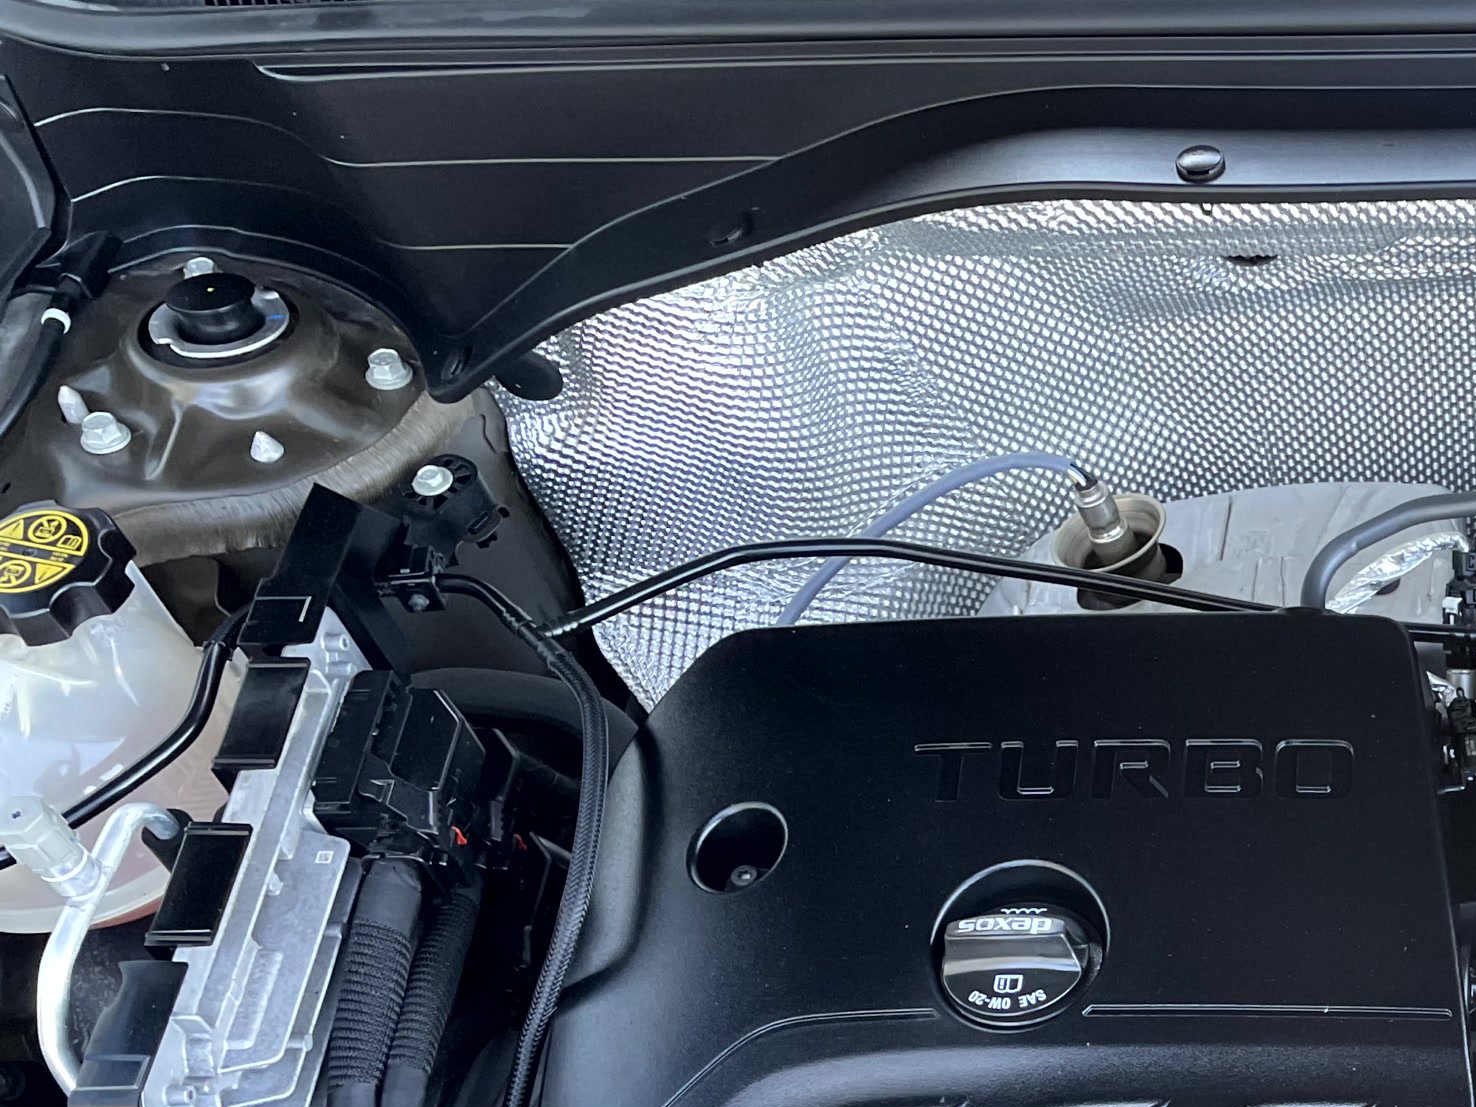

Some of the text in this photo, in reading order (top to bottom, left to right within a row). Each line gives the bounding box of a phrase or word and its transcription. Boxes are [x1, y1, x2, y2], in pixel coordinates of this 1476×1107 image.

[914, 738, 1355, 801] TURBO
[957, 917, 1053, 934] dexos
[968, 989, 1047, 1010] SAE 0W-20
